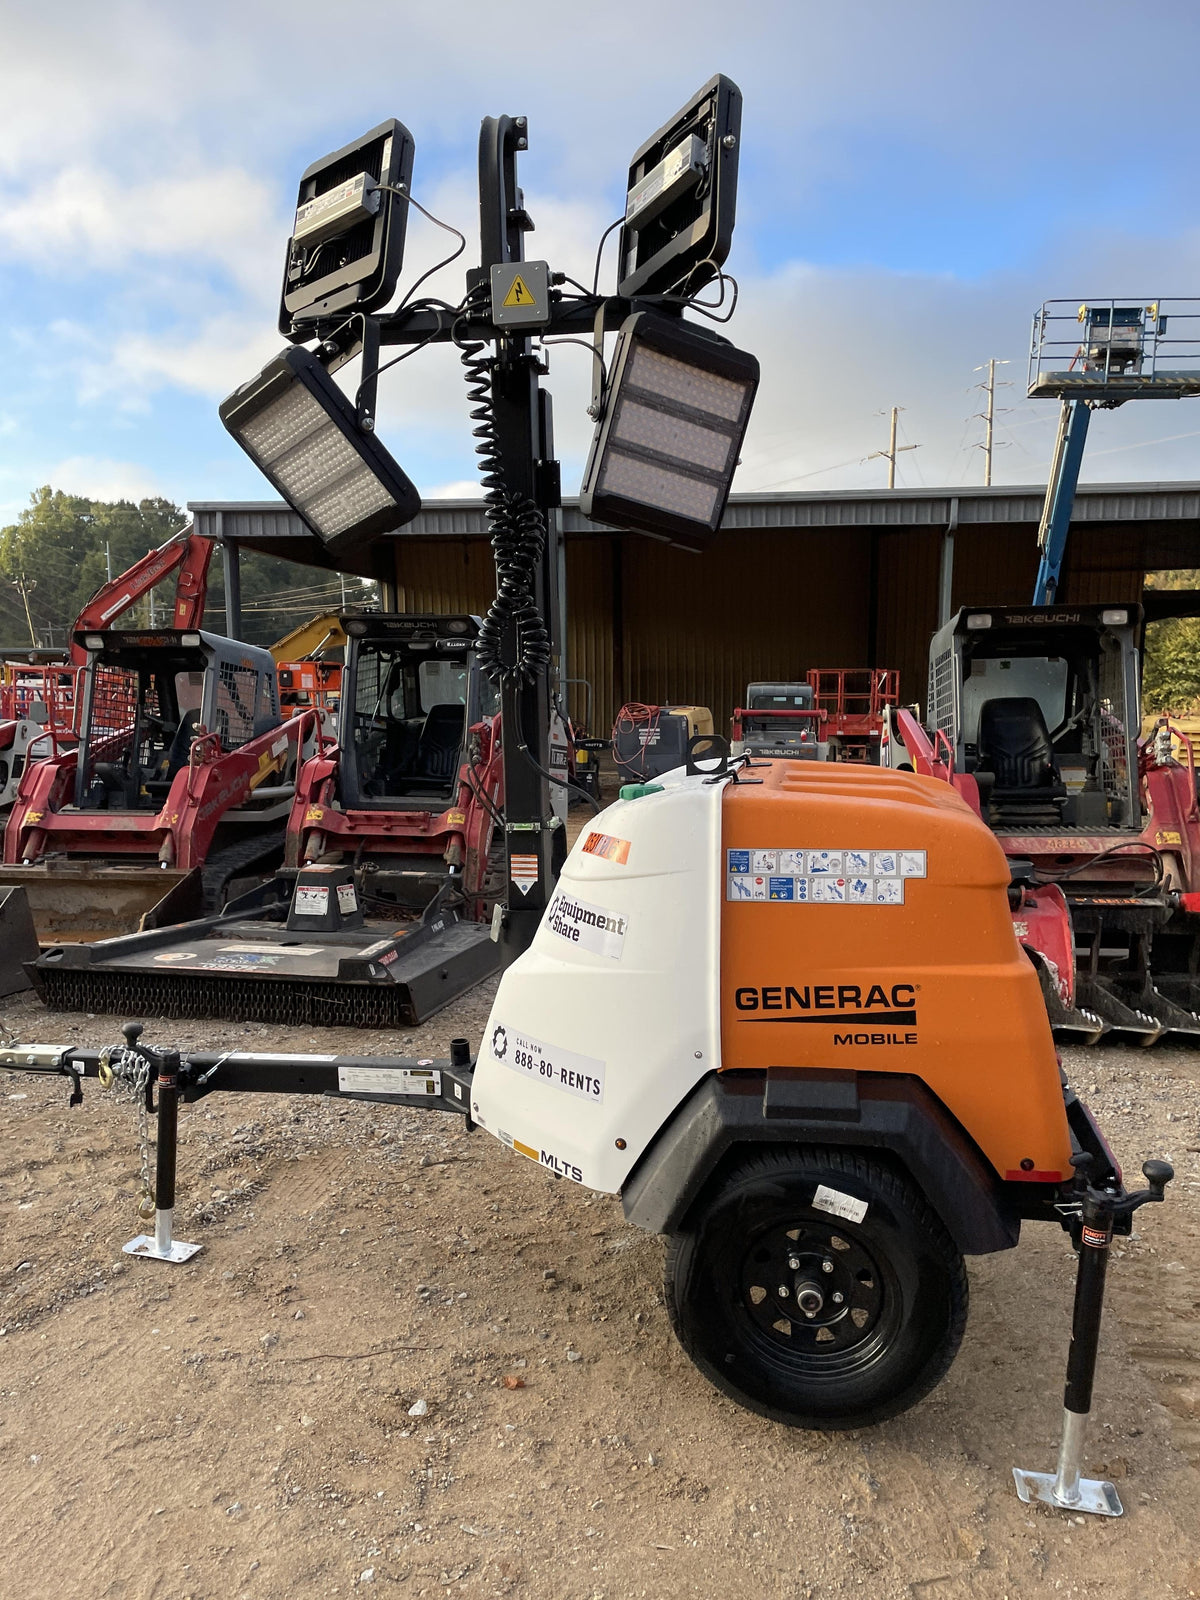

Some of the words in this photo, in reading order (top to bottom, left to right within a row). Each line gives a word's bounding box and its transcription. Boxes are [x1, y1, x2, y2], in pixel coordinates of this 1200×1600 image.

[383, 621, 438, 629] TAKEUCHI
[1005, 613, 1081, 624] TAKEUCHI
[759, 748, 800, 756] TAKEUCHI
[557, 895, 625, 936] Equipment
[551, 915, 580, 942] Share
[735, 984, 916, 1011] GENERAC
[515, 1037, 529, 1050] CALL
[530, 1043, 543, 1055] NOW
[833, 1033, 918, 1046] MOBILE
[514, 1049, 601, 1096] 888-80-RENTS
[540, 1149, 583, 1183] MLTS
